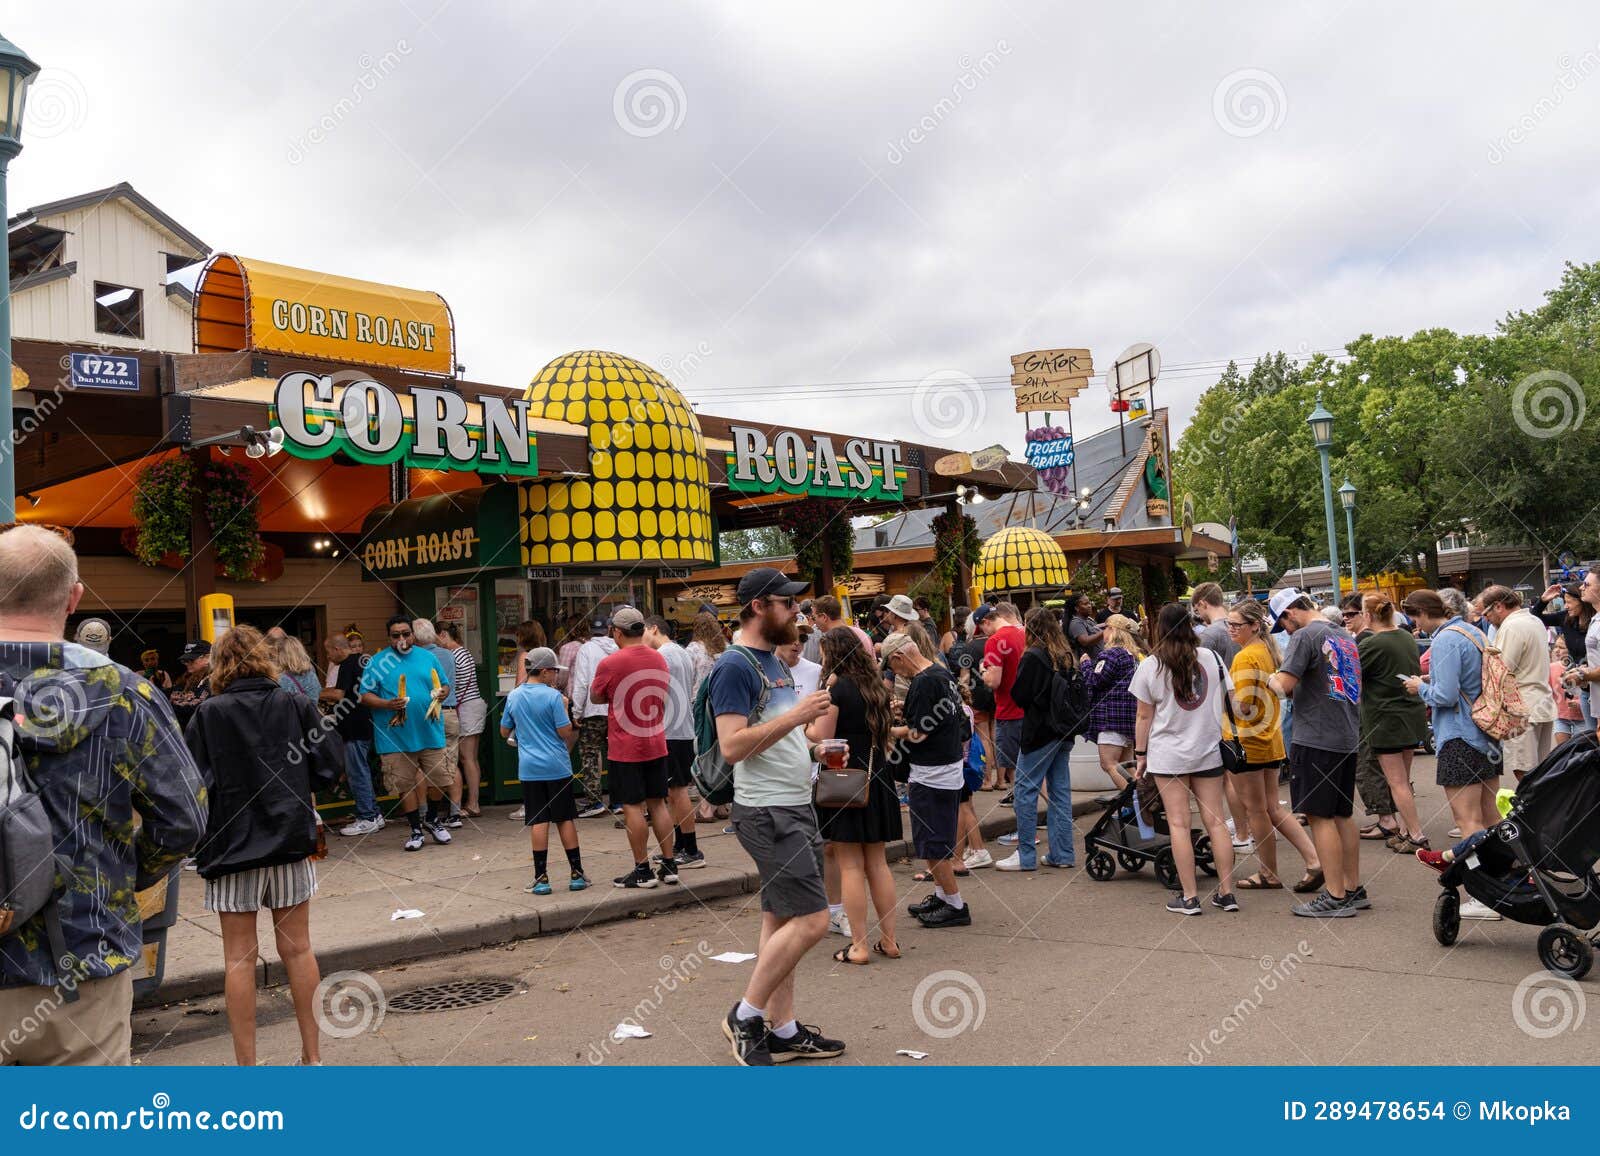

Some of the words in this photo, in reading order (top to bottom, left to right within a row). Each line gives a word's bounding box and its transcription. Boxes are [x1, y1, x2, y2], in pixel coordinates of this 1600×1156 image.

[272, 299, 348, 340] CORN
[356, 312, 435, 352] ROAST
[83, 359, 129, 376] 1722
[1023, 353, 1081, 374] GATOR
[96, 377, 118, 385] Patch
[1020, 390, 1064, 405] STICK
[274, 370, 531, 464] CORN
[730, 425, 901, 491] ROAST
[1026, 439, 1072, 457] FROZEN
[1030, 452, 1074, 468] GRAPES
[364, 537, 410, 571] CORN
[416, 526, 474, 565] ROAST
[530, 568, 560, 578] TICKETS
